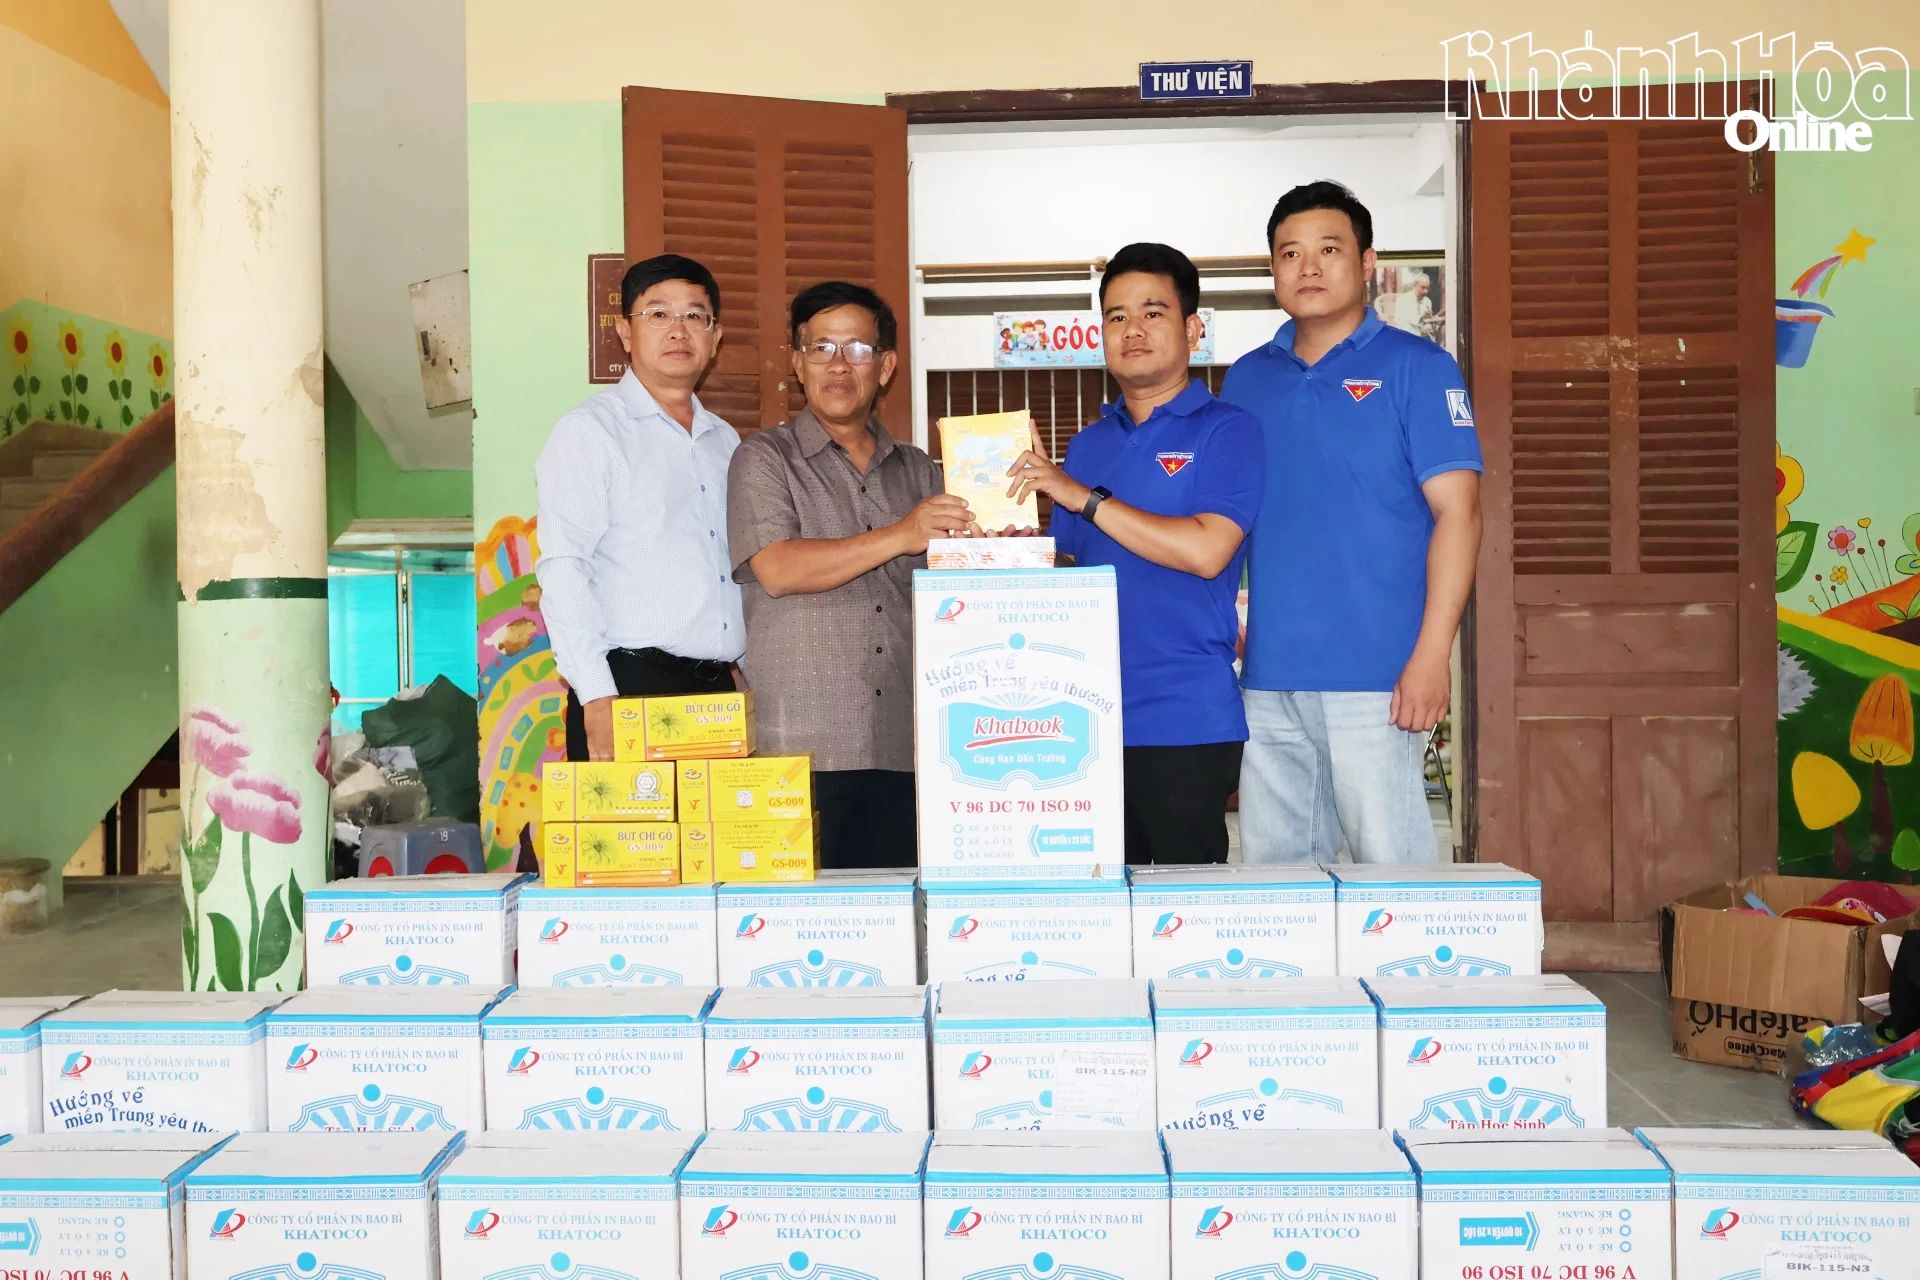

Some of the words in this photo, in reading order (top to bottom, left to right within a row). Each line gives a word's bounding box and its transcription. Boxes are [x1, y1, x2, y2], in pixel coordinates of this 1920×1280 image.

[1151, 68, 1190, 91] THƯ
[1195, 67, 1242, 94] VIỆN
[1053, 318, 1099, 350] GÓC
[967, 600, 992, 610] CÔNG
[996, 600, 1007, 609] TY
[1010, 598, 1023, 609] CỔ
[1056, 600, 1065, 608] IN
[1069, 600, 1087, 608] BAO
[1090, 598, 1099, 607] BÌ
[998, 613, 1069, 622] KHATOCO
[995, 653, 1018, 670] về
[686, 702, 704, 713] BÚT
[696, 715, 732, 724] GS-009
[973, 716, 1063, 737] Khabook
[974, 754, 995, 764] Cùng
[998, 754, 1015, 764] Bạn
[1017, 754, 1034, 763] Đến
[1037, 753, 1066, 764] Trường
[768, 796, 805, 807] GS-009
[950, 801, 961, 813] V
[967, 802, 983, 813] 96
[989, 801, 1012, 813] DC
[1018, 801, 1034, 812] 70
[1041, 800, 1069, 812] ISO
[1074, 800, 1091, 811] 90
[618, 830, 636, 841] BÚT
[1042, 836, 1048, 845] 10
[1072, 836, 1080, 844] 20
[627, 843, 664, 852] GS-009
[984, 851, 1014, 859] NGANG
[771, 858, 808, 869] GS-009
[1395, 912, 1420, 922] CÔNG
[1424, 914, 1434, 922] TY
[1438, 910, 1450, 922] CỔ
[1518, 911, 1527, 921] BÌ
[355, 922, 380, 932] CÔNG
[383, 924, 394, 932] TY
[397, 921, 409, 931] CỔ
[474, 922, 483, 931] BÌ
[1426, 926, 1496, 935] KHATOCO
[386, 936, 454, 944] KHATOCO
[1444, 1041, 1472, 1052] CÔNG
[1476, 1043, 1488, 1051] TY
[1491, 1039, 1505, 1051] CỔ
[1509, 1038, 1537, 1051] PHẦN
[1541, 1042, 1551, 1050] IN
[1555, 1042, 1575, 1050] BAO
[1579, 1040, 1588, 1050] BÌ
[93, 1056, 120, 1066] CÔNG
[124, 1058, 135, 1066] TY
[138, 1055, 151, 1066] CỔ
[185, 1059, 194, 1067] IN
[197, 1059, 217, 1067] BAO
[220, 1057, 229, 1067] BÌ
[994, 1055, 1022, 1066] CÔNG
[1025, 1056, 1038, 1065] TY
[1478, 1056, 1556, 1065] KHATOCO
[127, 1071, 199, 1080] KHATOCO
[1075, 1067, 1146, 1076] BIK-115-N3
[49, 1089, 113, 1117] Hướng
[122, 1086, 145, 1104] về
[1242, 1103, 1267, 1121] về
[64, 1107, 104, 1129] miền
[108, 1107, 154, 1126] Trung
[160, 1113, 187, 1130] yêu
[740, 1211, 770, 1222] CÔNG
[774, 1214, 787, 1222] TY
[791, 1209, 806, 1223] CỔ
[810, 1210, 840, 1223] PHẦN
[845, 1214, 856, 1223] IN
[860, 1215, 882, 1224] BAO
[886, 1213, 896, 1224] BÌ
[1558, 1211, 1594, 1219] NGANG
[1742, 1213, 1774, 1224] CÔNG
[1778, 1216, 1792, 1225] TY
[1797, 1212, 1813, 1225] CỔ
[1817, 1214, 1850, 1226] PHẦN
[1854, 1217, 1866, 1226] IN
[1871, 1217, 1894, 1227] BAO
[1898, 1215, 1910, 1227] BÌ
[777, 1228, 861, 1239] KHATOCO
[1477, 1227, 1486, 1237] 20
[1514, 1226, 1523, 1237] 10
[1559, 1227, 1570, 1235] LY
[1588, 1227, 1593, 1235] 5
[1781, 1231, 1871, 1242] KHATOCO
[1462, 1265, 1483, 1280] 90
[1489, 1265, 1525, 1280] ISO
[1531, 1265, 1553, 1280] 70
[1559, 1265, 1588, 1279] DC
[1594, 1265, 1616, 1280] 96
[1623, 1266, 1636, 1280] V
[1787, 1262, 1870, 1273] BIK-115-N3
